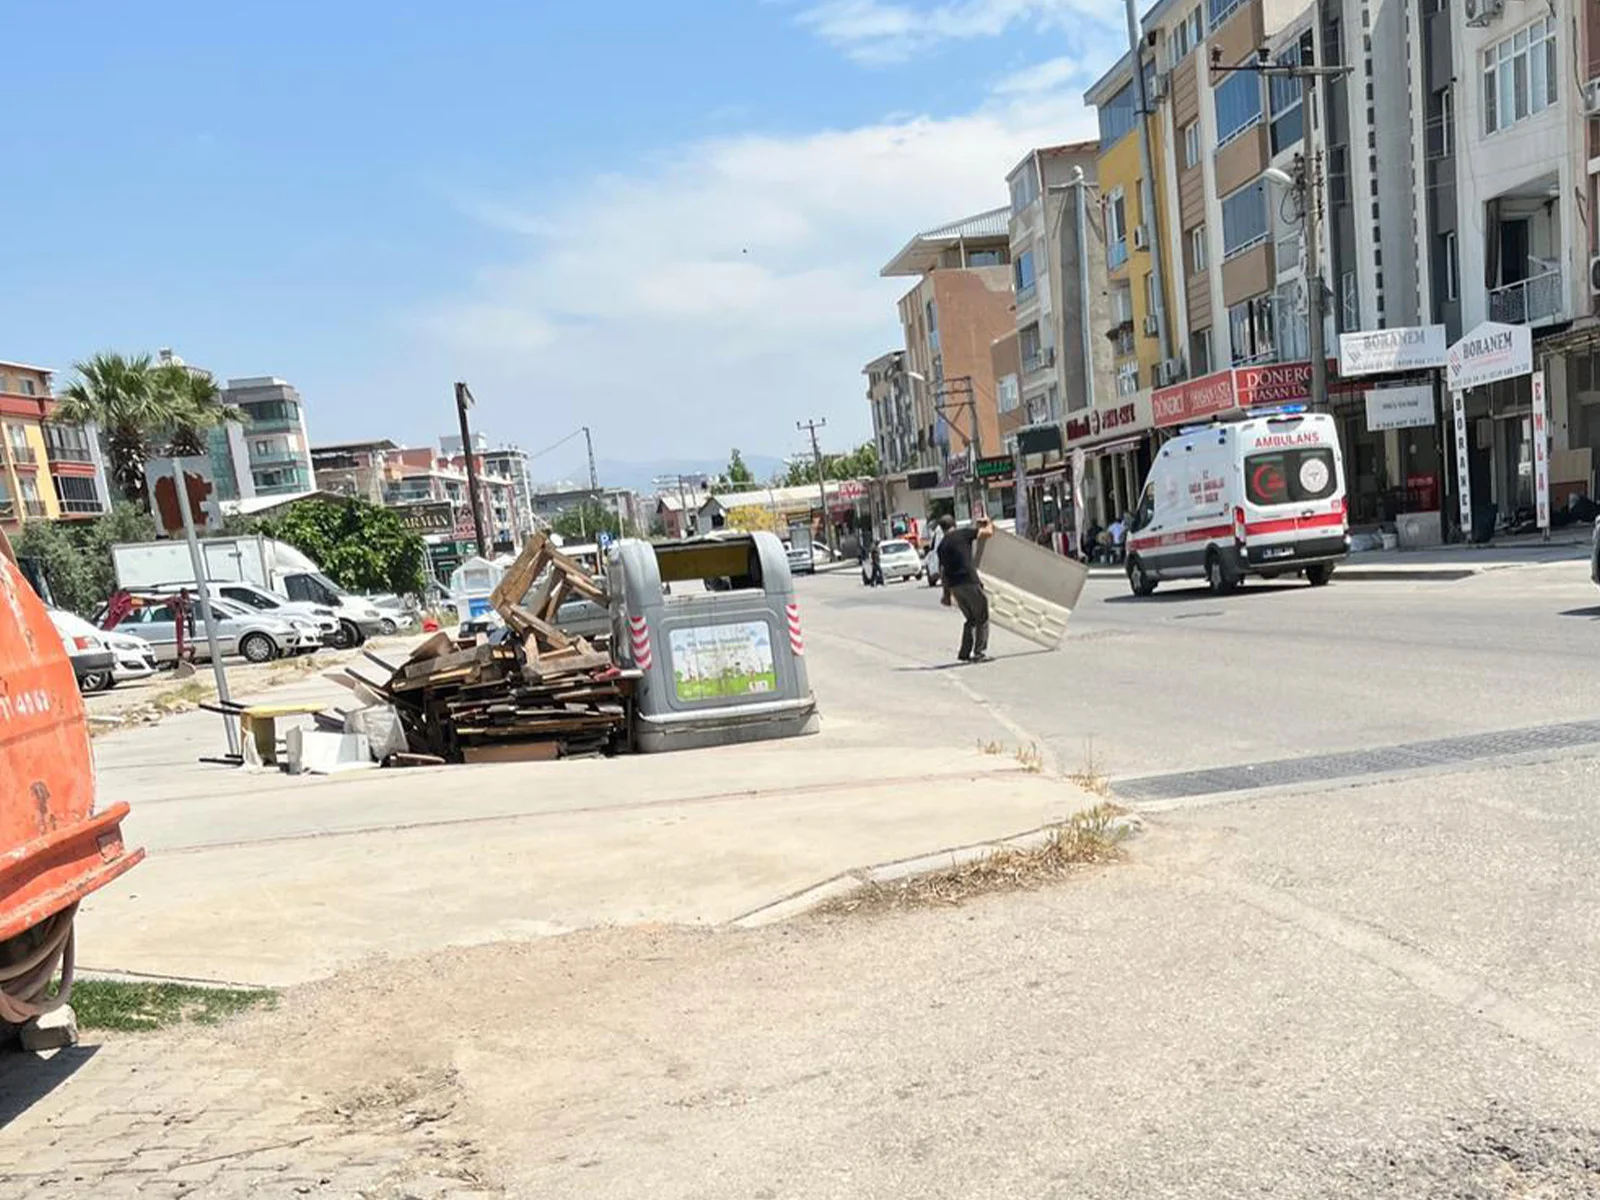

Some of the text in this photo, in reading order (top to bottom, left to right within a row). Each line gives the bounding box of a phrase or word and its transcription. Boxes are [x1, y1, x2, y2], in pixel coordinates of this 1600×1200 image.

[1364, 330, 1425, 350] BORANEM
[1463, 331, 1513, 359] BORANEM
[1248, 387, 1290, 402] HASAN
[1255, 432, 1320, 447] AMBULANS
[1534, 382, 1547, 521] EMLAK
